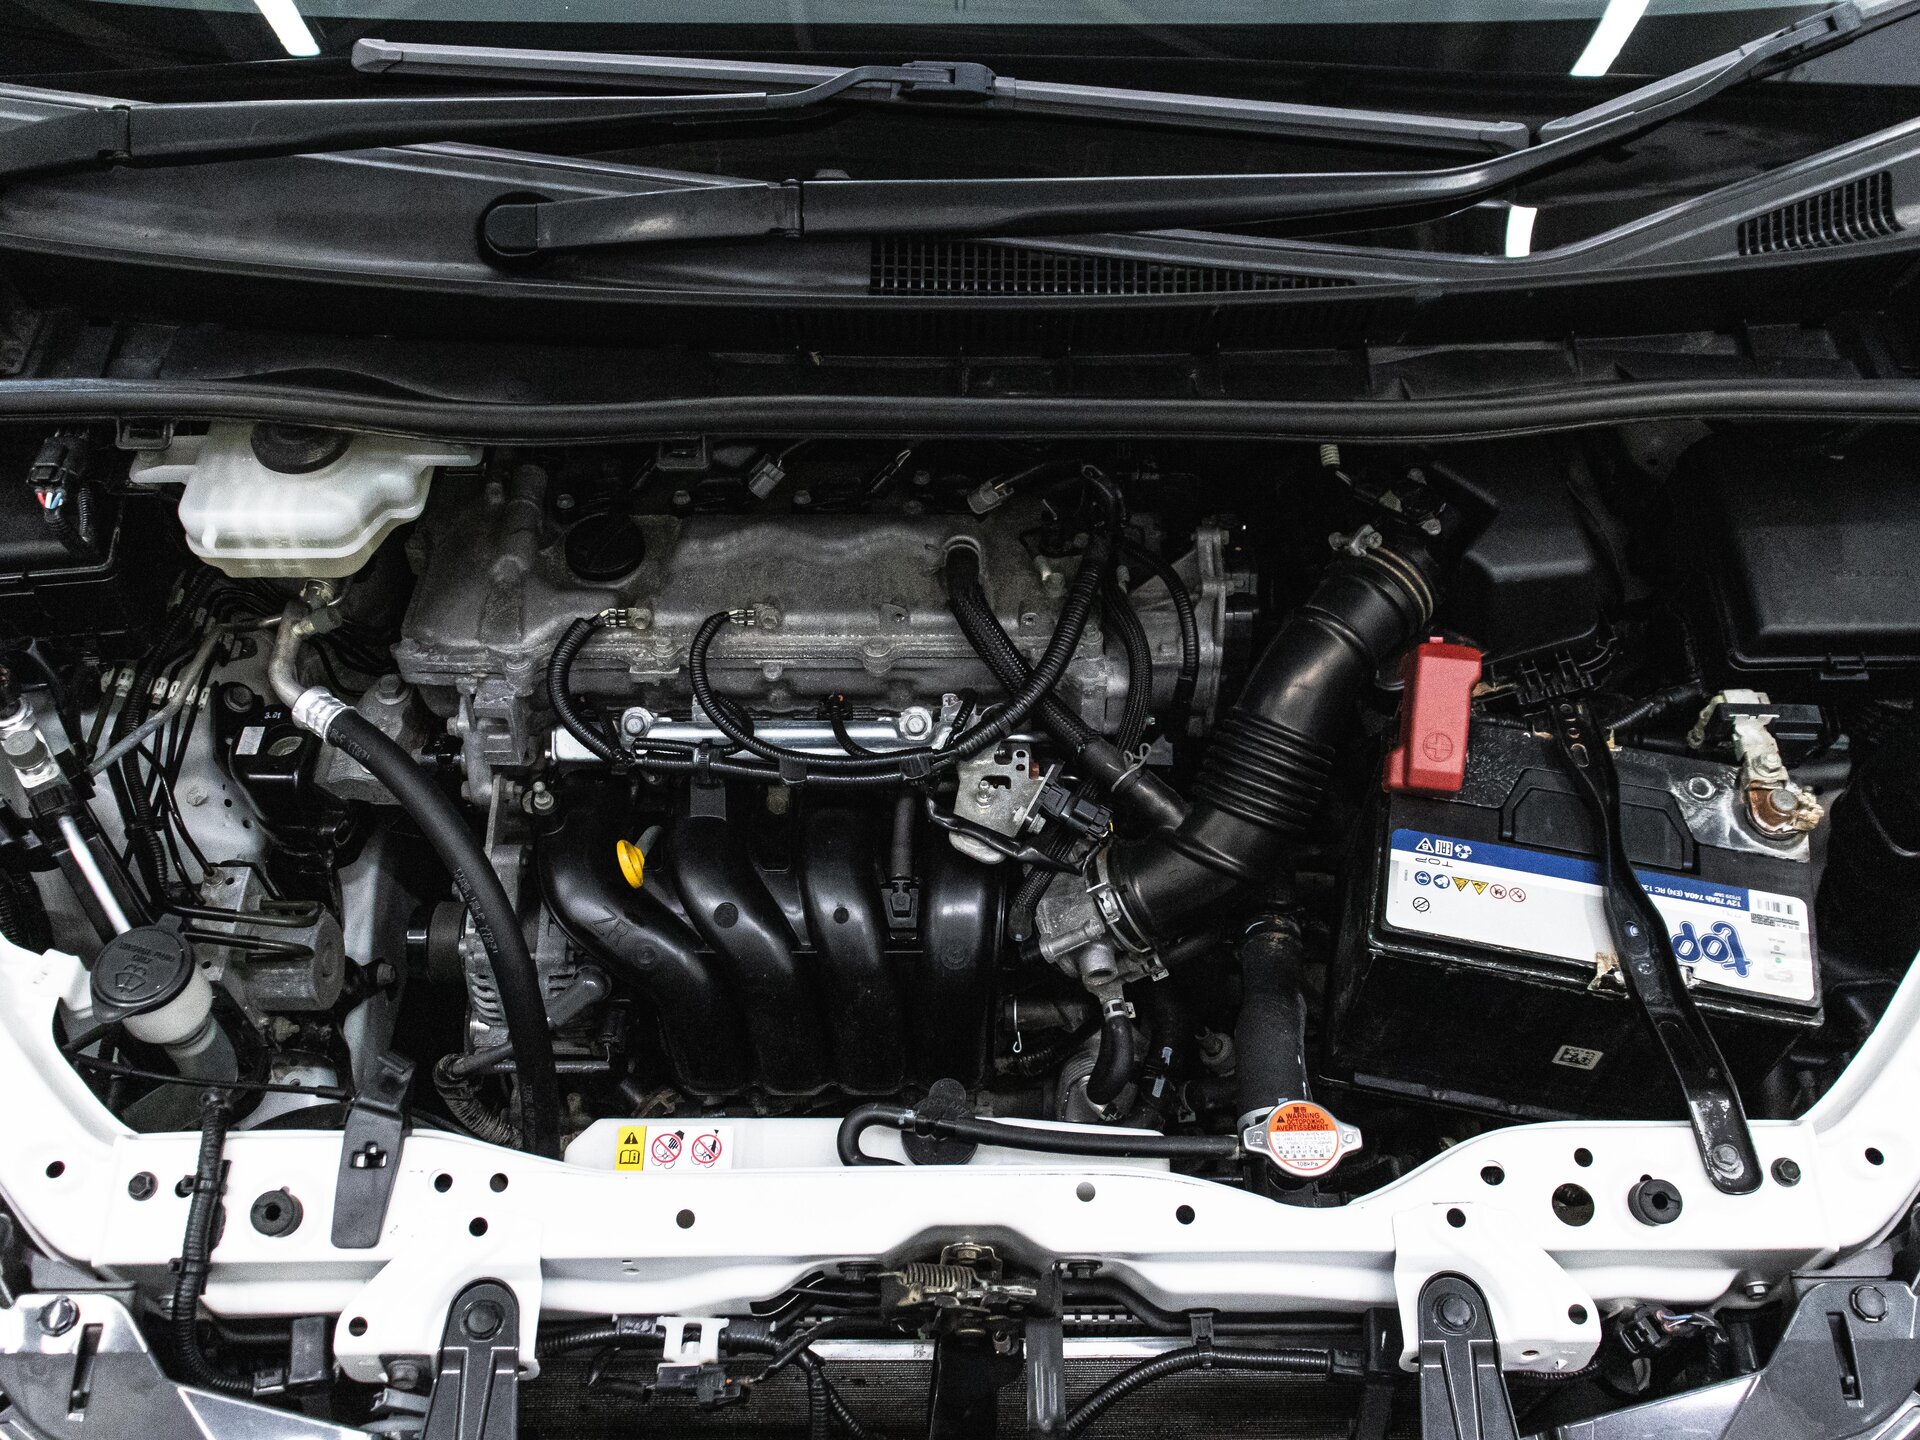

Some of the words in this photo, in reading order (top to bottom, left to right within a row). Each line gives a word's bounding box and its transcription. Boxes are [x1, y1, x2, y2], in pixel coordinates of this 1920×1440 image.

[1415, 857, 1453, 868] TOP
[1654, 886, 1666, 894] RC
[1667, 887, 1683, 897] (EN)
[1684, 891, 1704, 901] 740A
[1705, 895, 1725, 905] 75Ah
[1727, 899, 1742, 908] 12V
[1671, 920, 1753, 978] top
